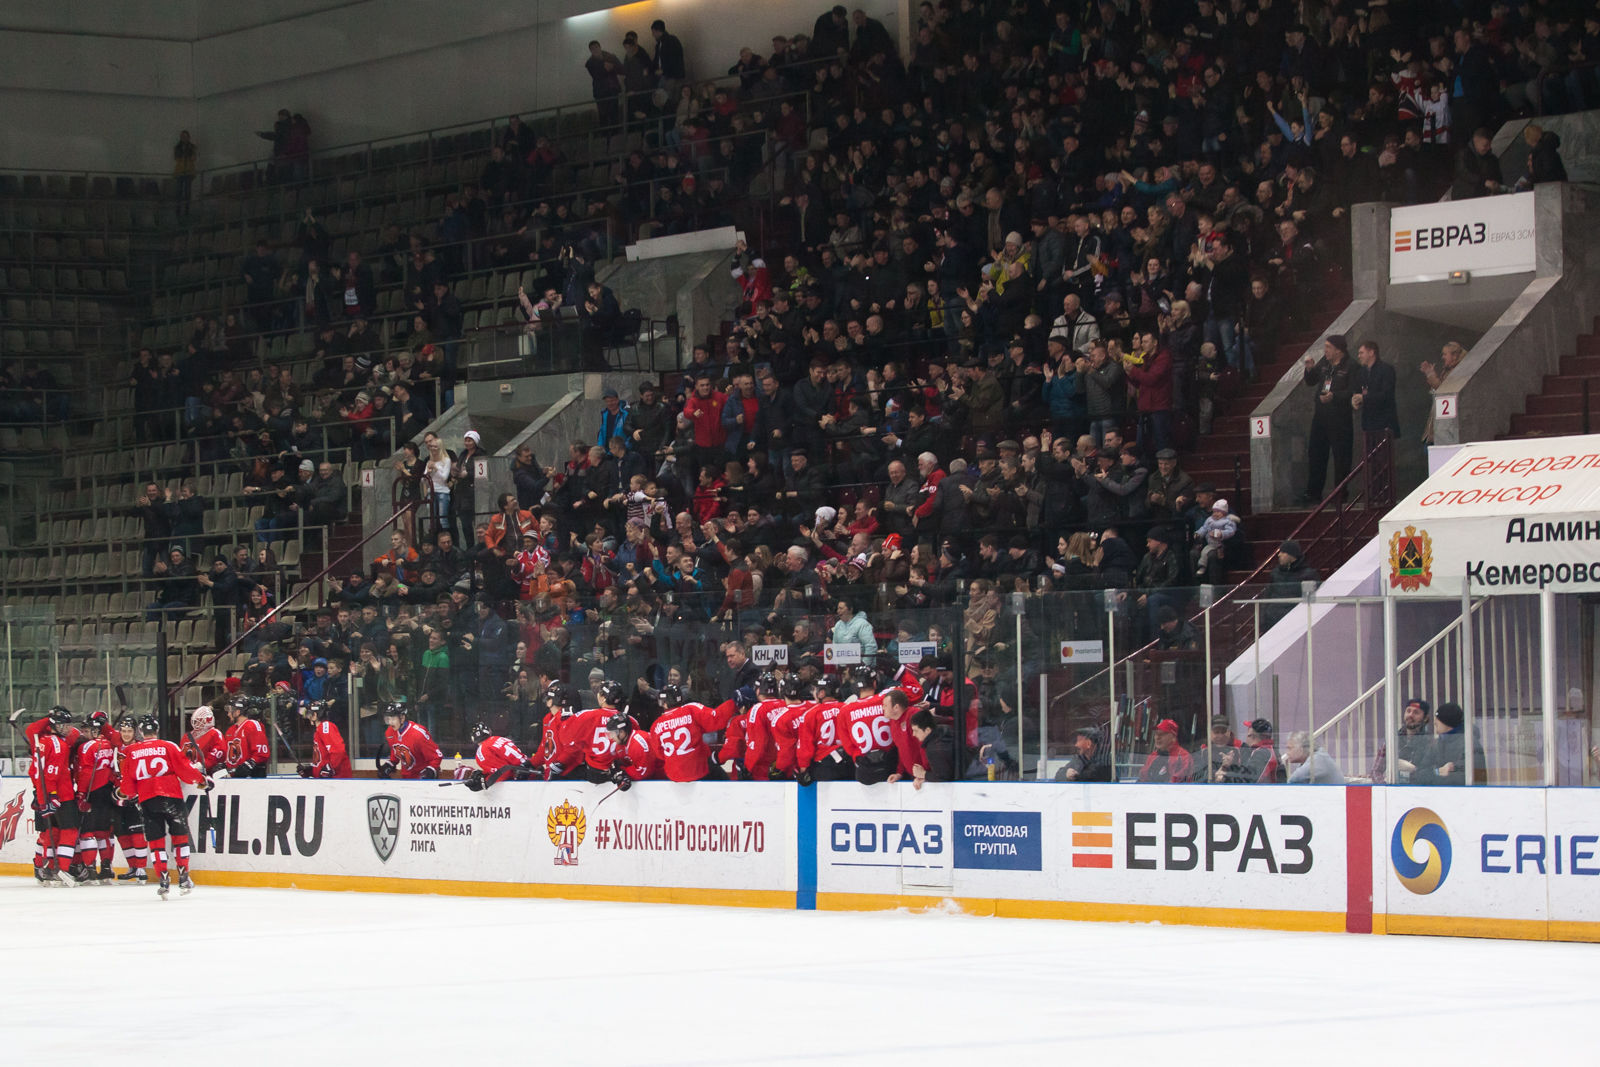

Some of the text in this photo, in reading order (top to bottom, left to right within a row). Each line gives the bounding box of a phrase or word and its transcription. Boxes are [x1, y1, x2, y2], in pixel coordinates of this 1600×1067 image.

[1416, 222, 1487, 251] ЕВРАЗ
[1490, 231, 1516, 243] ЕВРАЗ
[1442, 399, 1450, 416] 2
[1256, 419, 1264, 435] 3
[478, 463, 483, 476] 3
[365, 472, 370, 484] 4
[1420, 484, 1562, 507] спонсор
[754, 648, 786, 661] KHL.RU
[836, 650, 859, 658] ERIELL
[900, 648, 920, 656] СОГАЗ
[1075, 647, 1101, 655] mastercard
[850, 704, 884, 722] ЛЯМКИН
[660, 726, 695, 757] 52
[851, 715, 894, 754] 96
[131, 747, 167, 760] ЗИНОВЬЕВ
[211, 748, 223, 758] 20
[256, 744, 268, 754] 70
[47, 764, 59, 775] 81
[135, 757, 169, 780] 42
[409, 805, 511, 819] КОНТИНЕНТАЛЬНАЯ
[410, 820, 472, 836] ХОККЕЙНАЯ
[964, 824, 1028, 838] СТРАХОВАЯ
[410, 839, 436, 852] ЛИГА
[831, 822, 944, 855] СОГАЗ
[1125, 812, 1314, 875] ЕВРАЗ
[974, 842, 1018, 856] ГРУППА
